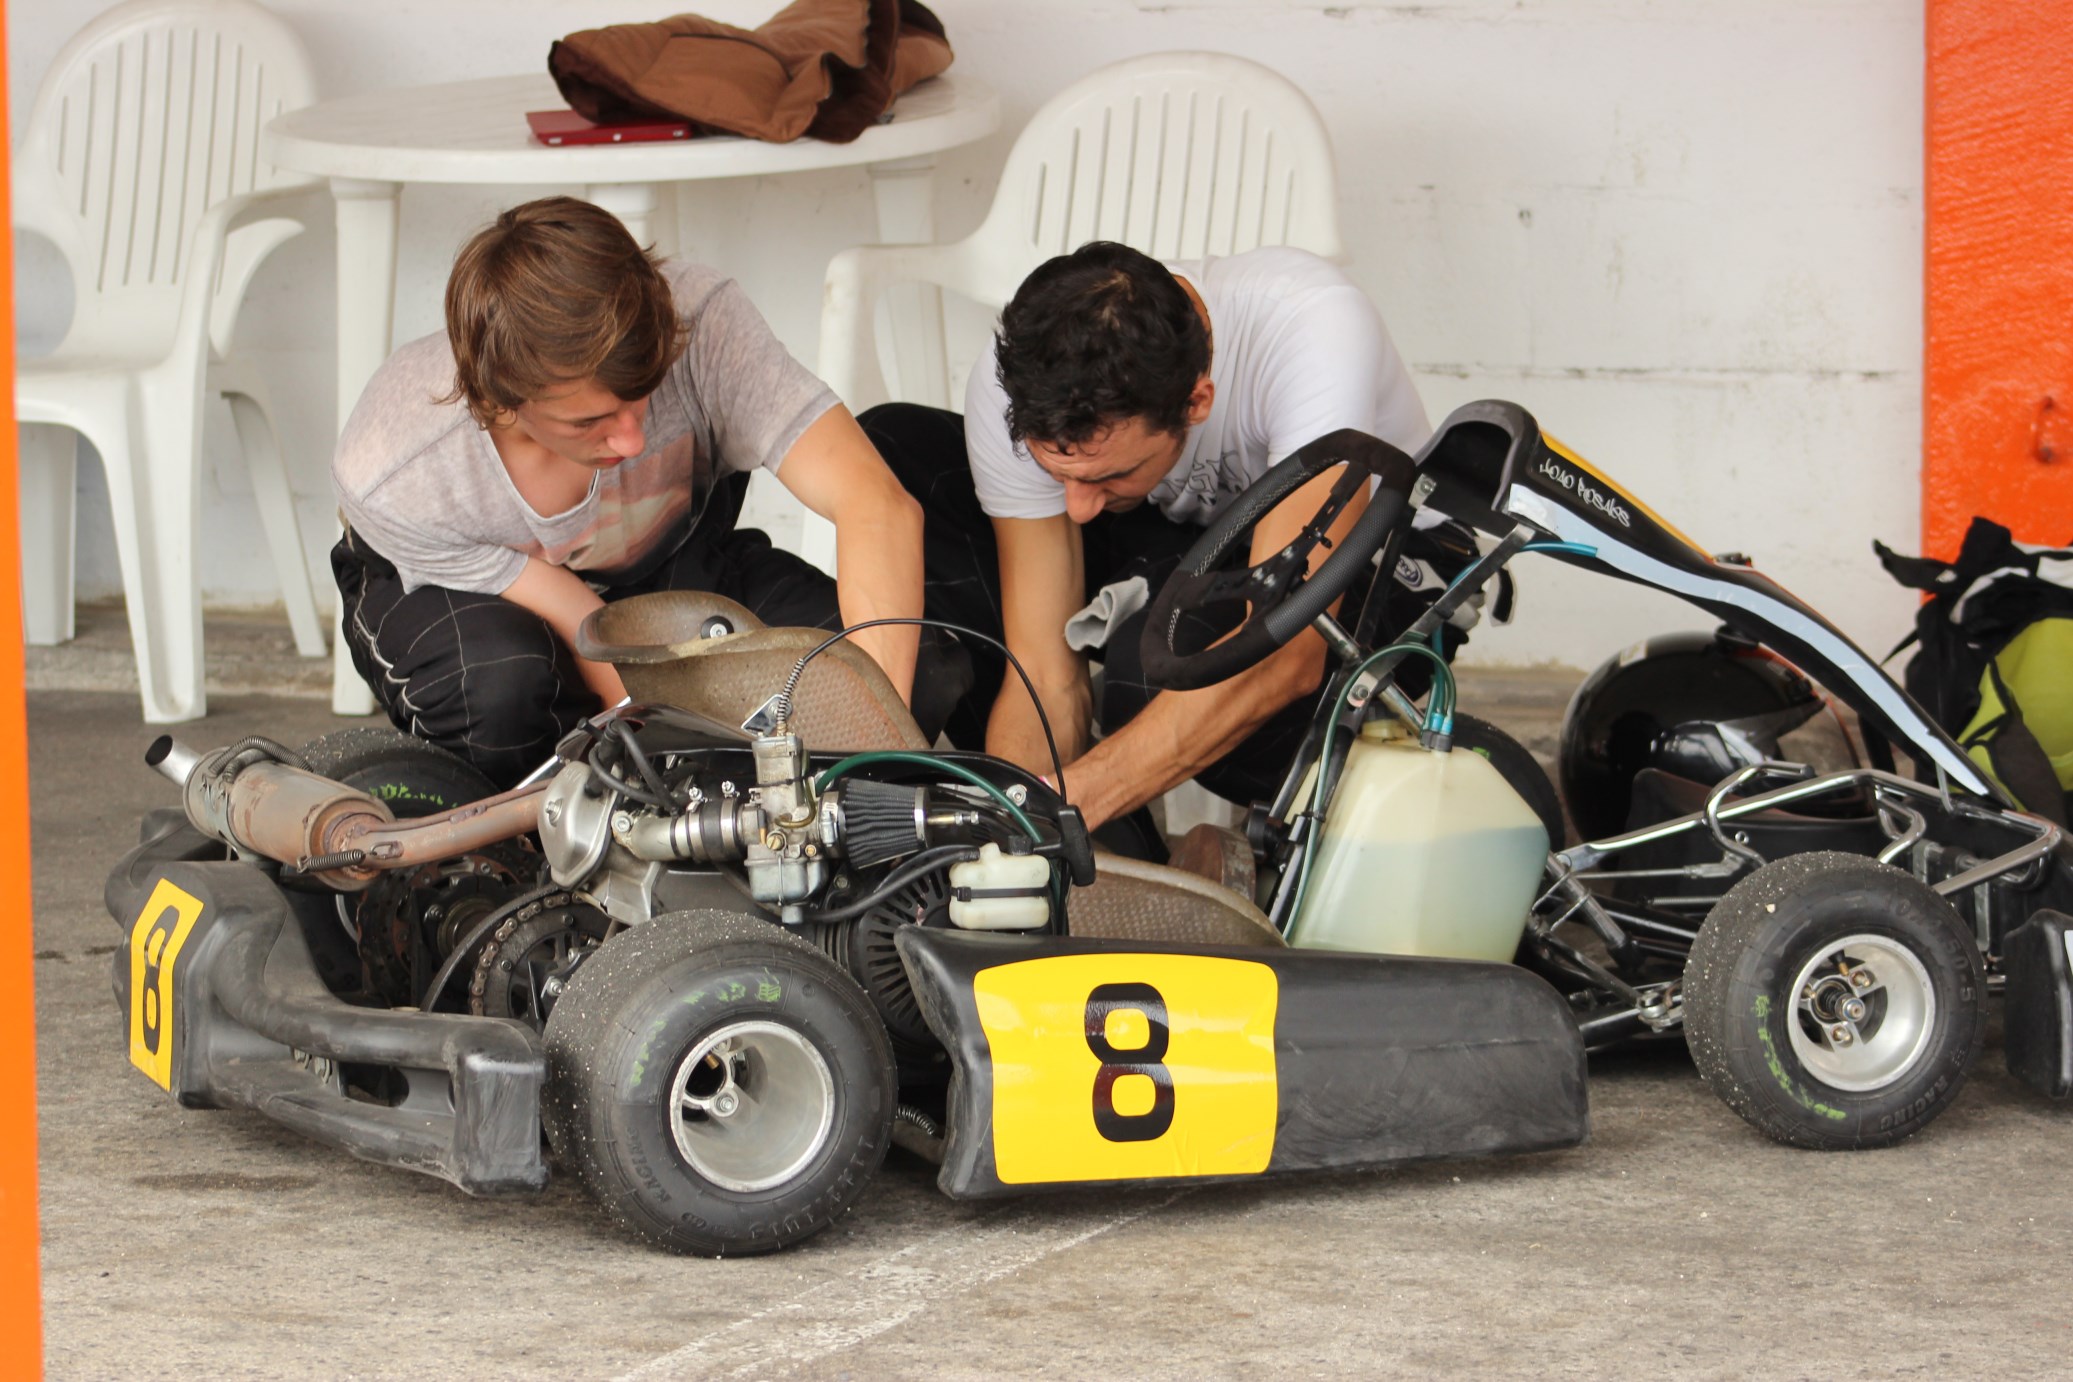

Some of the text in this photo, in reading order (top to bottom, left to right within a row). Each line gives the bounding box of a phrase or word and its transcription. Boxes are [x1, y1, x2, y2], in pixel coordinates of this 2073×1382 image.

[142, 904, 180, 1056] 8
[1084, 982, 1175, 1142] 8
[1880, 1075, 1948, 1131] RACING
